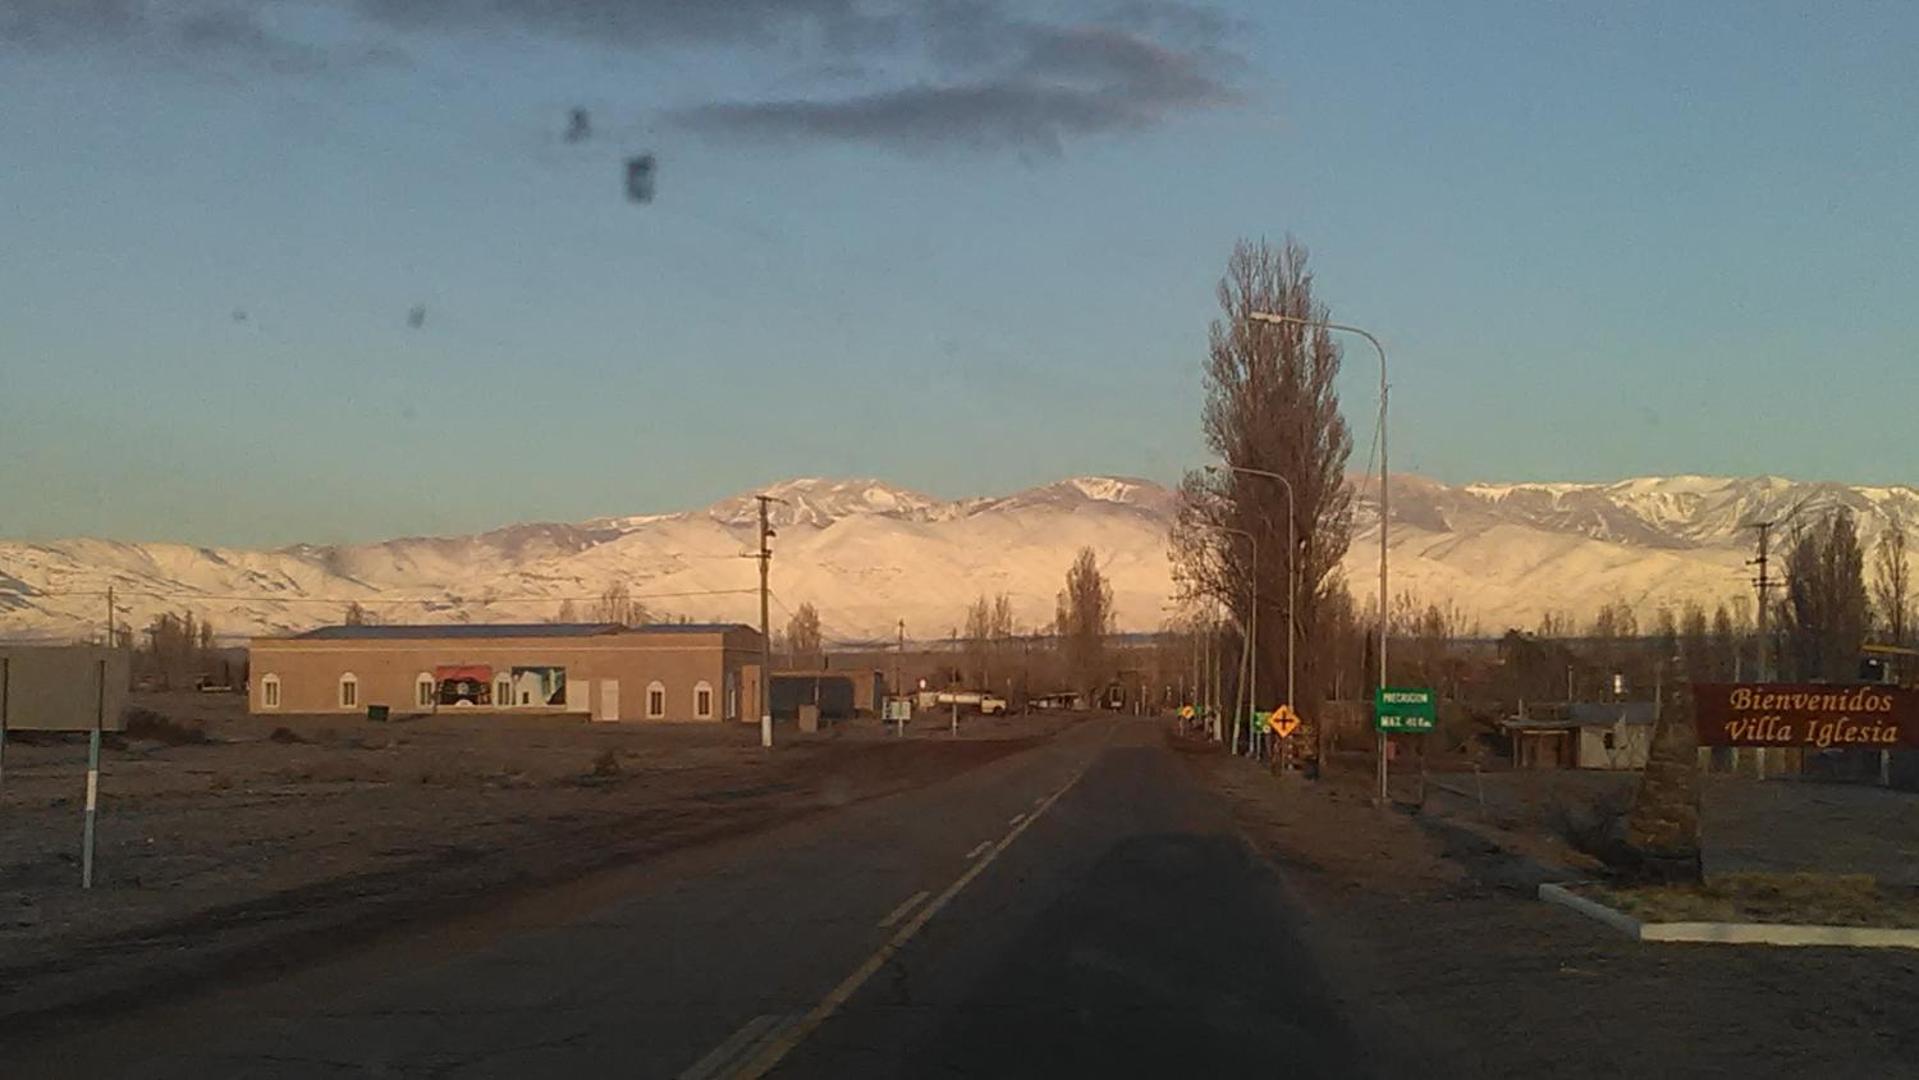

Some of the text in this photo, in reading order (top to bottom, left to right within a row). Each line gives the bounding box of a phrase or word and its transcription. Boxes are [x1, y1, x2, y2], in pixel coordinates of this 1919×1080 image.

[1730, 686, 1893, 711] Bienvenidos
[1725, 716, 1898, 747] Villa Iglesia
